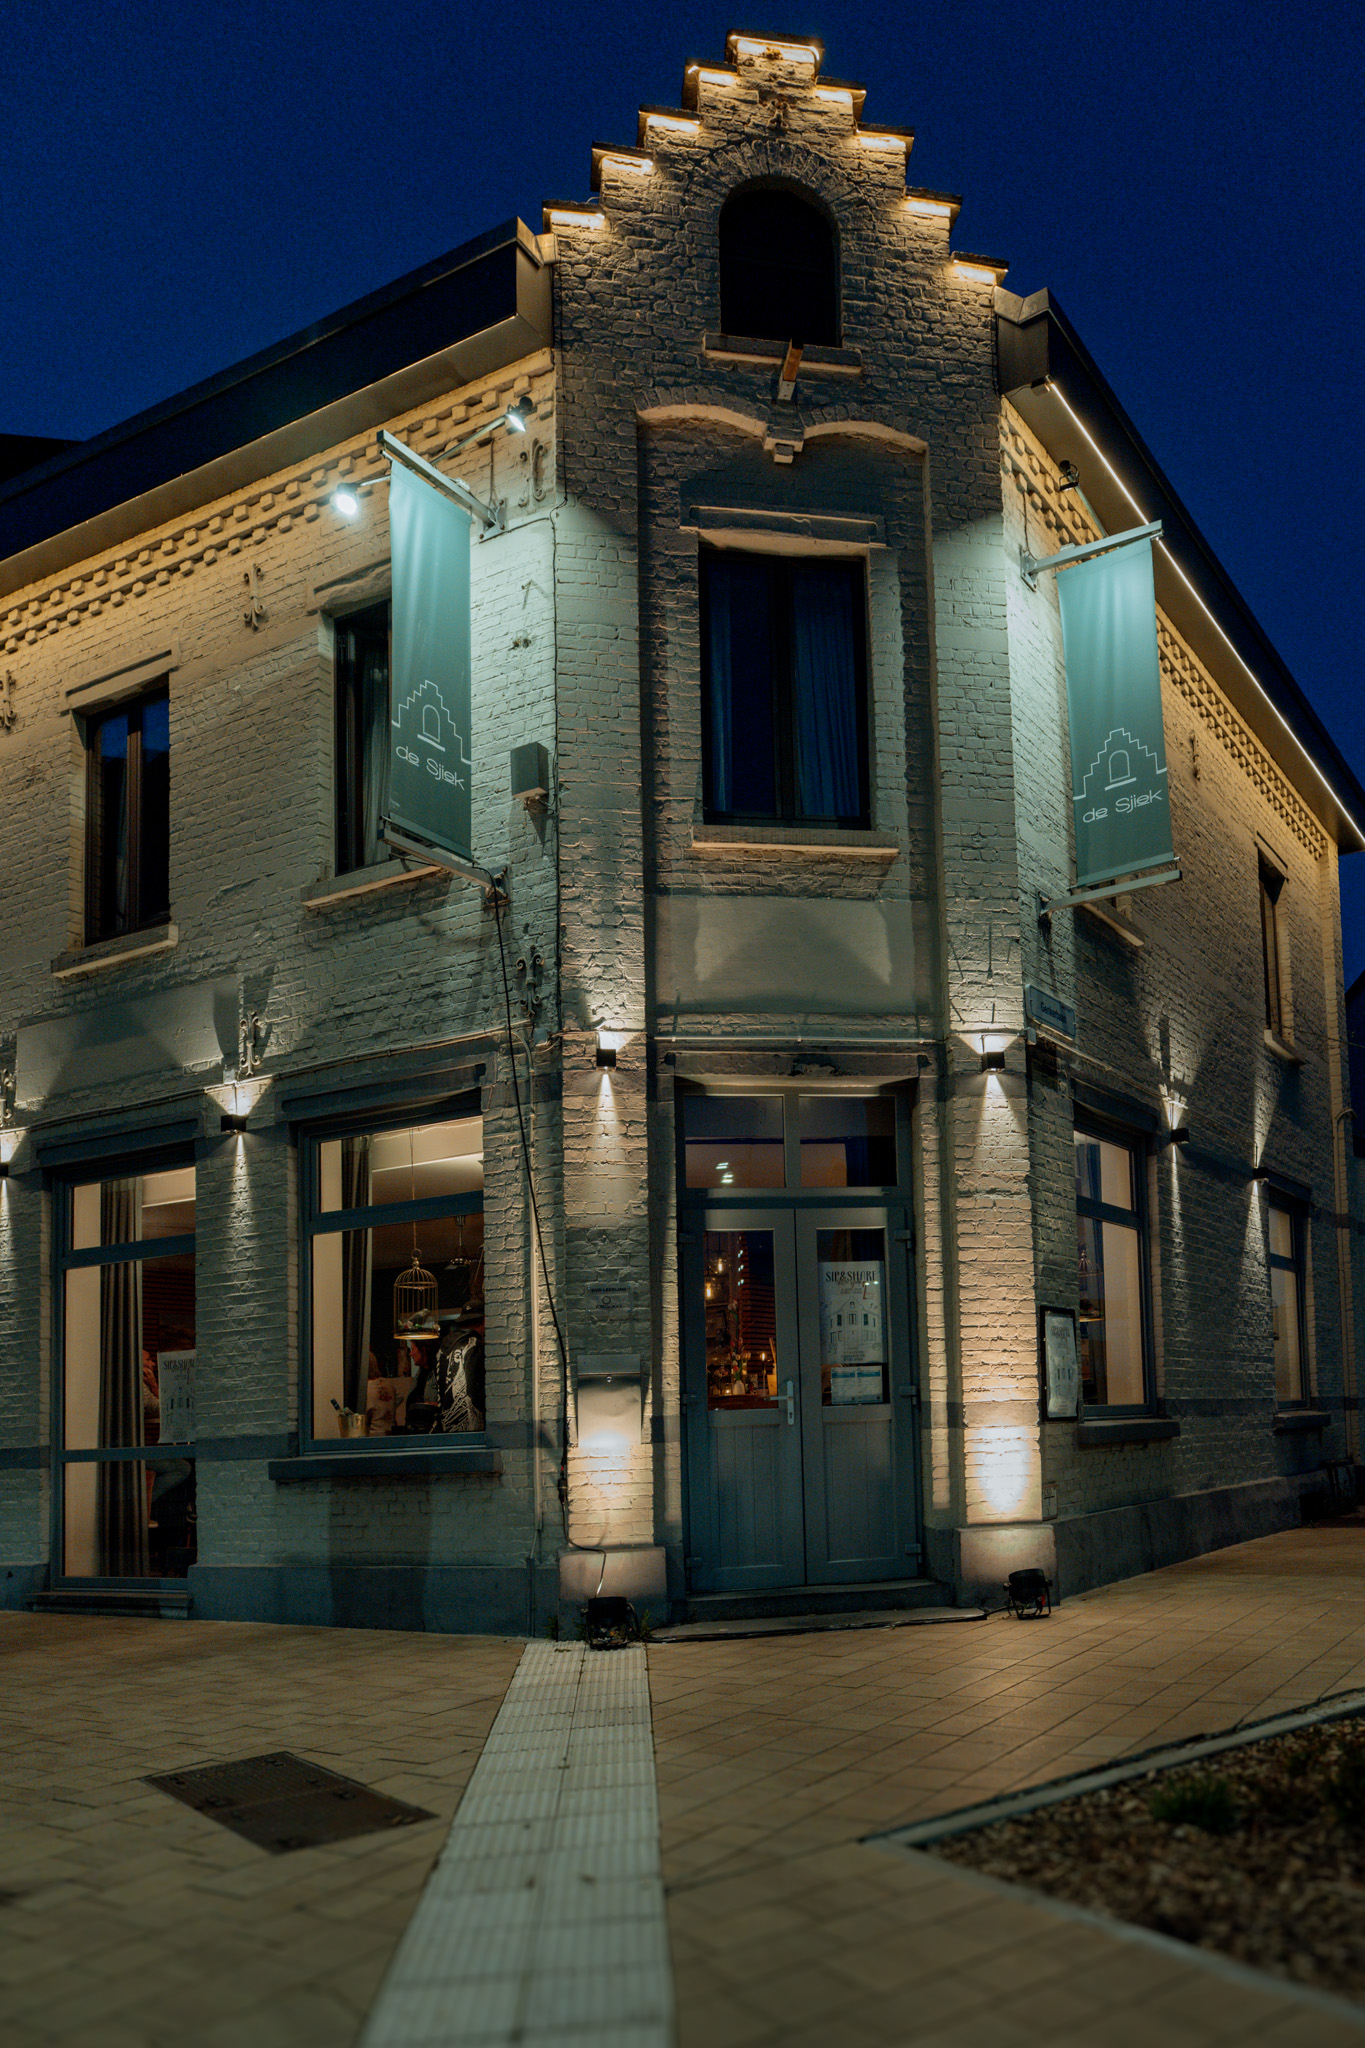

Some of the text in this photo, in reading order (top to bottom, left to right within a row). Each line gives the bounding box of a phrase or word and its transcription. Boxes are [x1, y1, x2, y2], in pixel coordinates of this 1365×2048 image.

[396, 746, 465, 790] de Sjiek
[1082, 790, 1162, 823] de Sjiek
